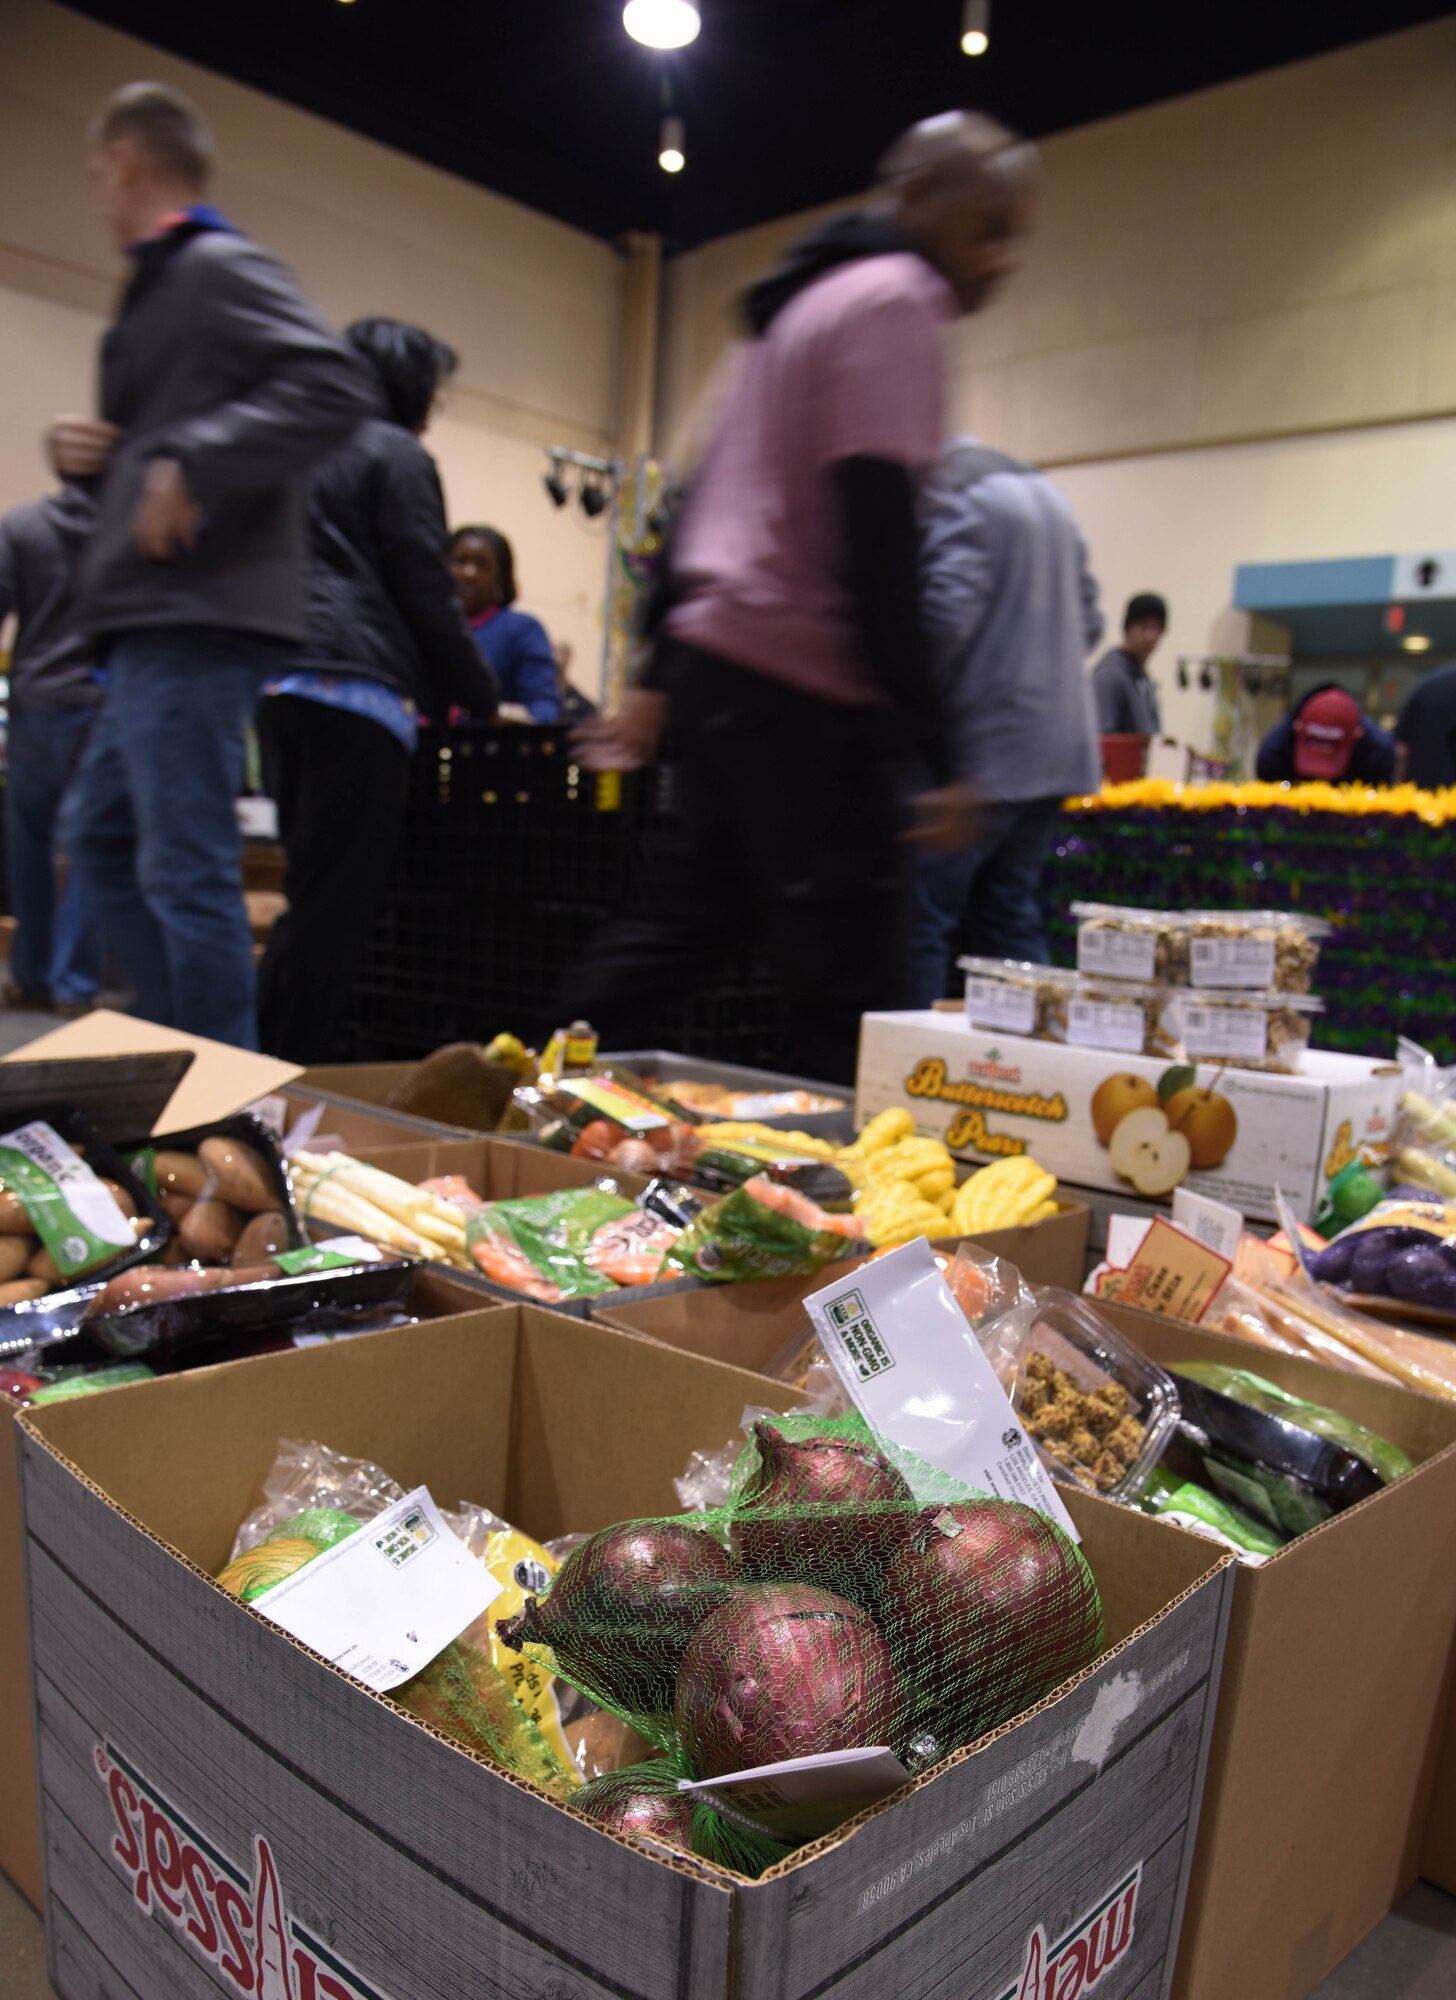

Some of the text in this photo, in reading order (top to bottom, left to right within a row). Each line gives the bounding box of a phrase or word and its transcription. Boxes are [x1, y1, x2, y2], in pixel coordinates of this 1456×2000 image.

[906, 1057, 1067, 1122] Butterscotch
[840, 1329, 862, 1363] & MORE
[849, 1323, 880, 1372] NON-GMO
[860, 1318, 890, 1366] ORGANIC IS
[997, 1461, 1012, 1485] Certified
[1009, 1453, 1019, 1466] LOS
[1030, 1493, 1038, 1502] CA
[1015, 1450, 1030, 1471] WORLD
[1028, 1765, 1049, 1793] 5325
[996, 1789, 1016, 1811] Soto
[960, 1816, 977, 1837] Los
[916, 1829, 957, 1867] Angeles,
[900, 1861, 914, 1884] CA
[862, 1871, 898, 1910] 90058
